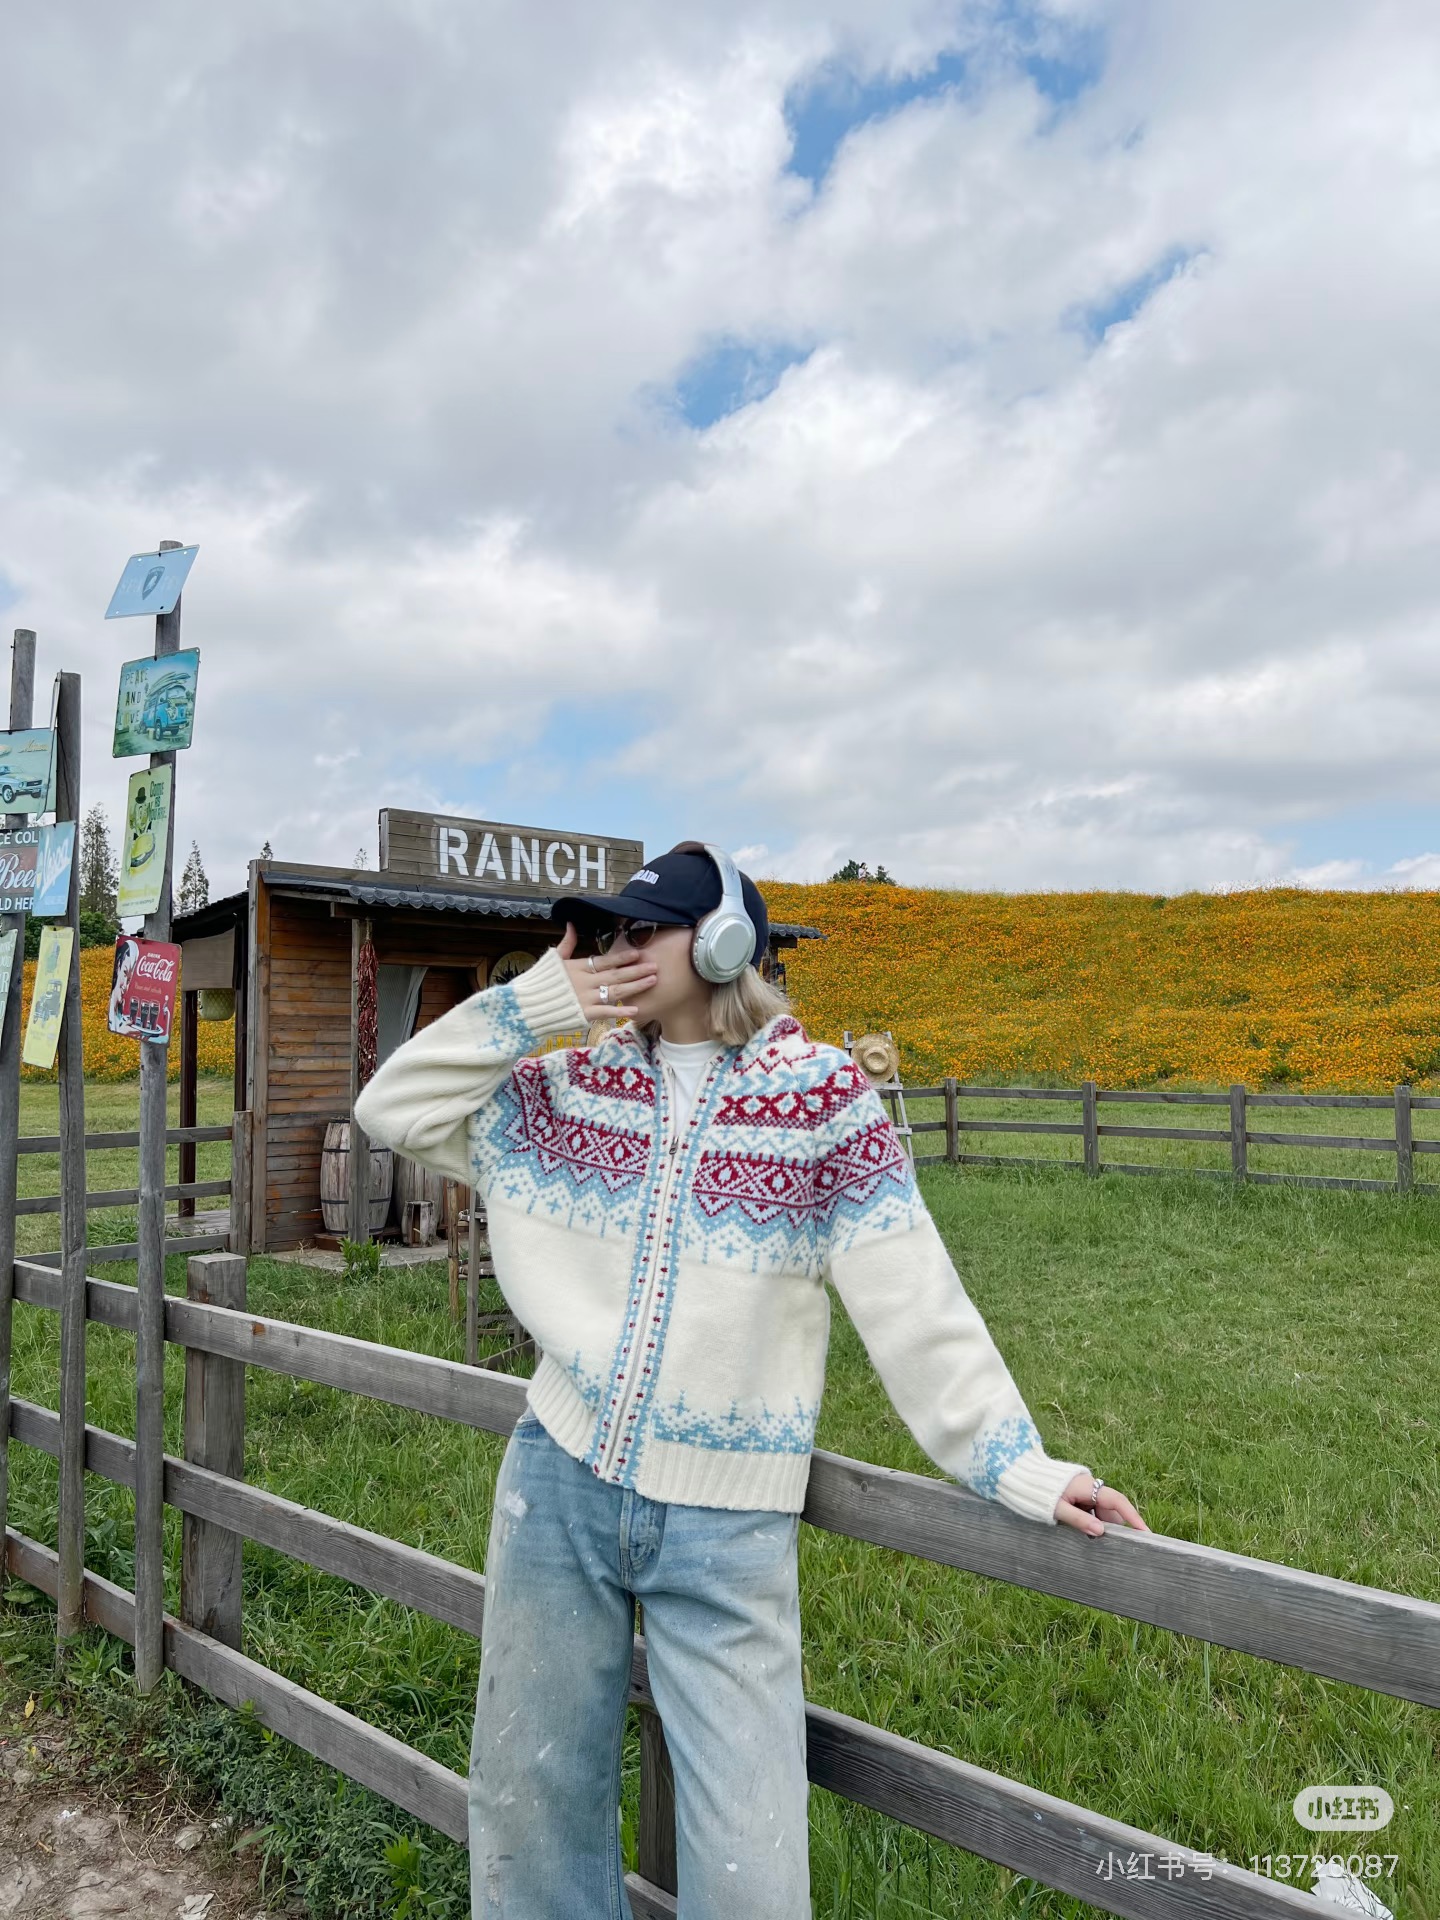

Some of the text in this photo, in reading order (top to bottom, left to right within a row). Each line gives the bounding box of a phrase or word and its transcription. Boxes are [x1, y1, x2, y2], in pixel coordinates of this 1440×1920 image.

[126, 691, 141, 706] AND
[15, 831, 39, 844] COL
[439, 827, 606, 889] RANCH
